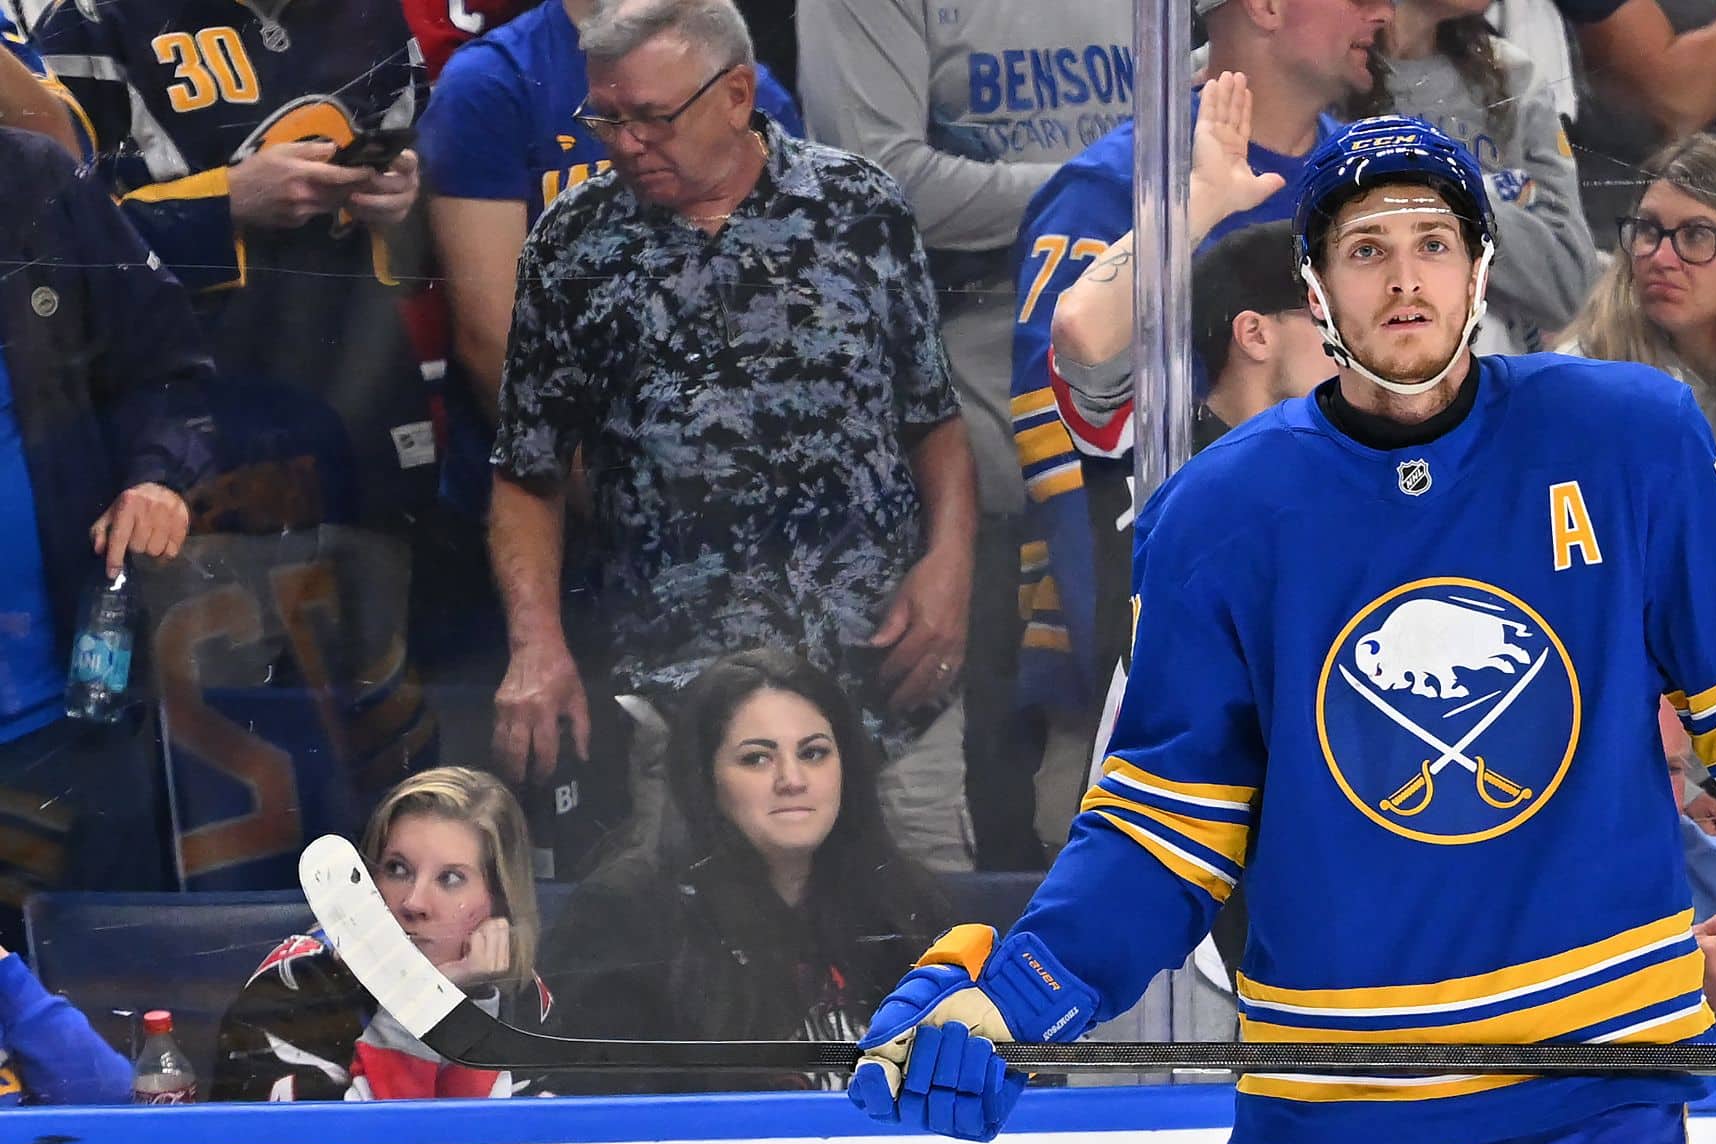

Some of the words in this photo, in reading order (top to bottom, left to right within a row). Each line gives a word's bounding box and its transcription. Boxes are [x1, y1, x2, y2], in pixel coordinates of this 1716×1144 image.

[151, 26, 260, 113] 30
[968, 45, 1133, 114] BENSON
[1351, 134, 1417, 151] CCM
[1549, 480, 1603, 571] A
